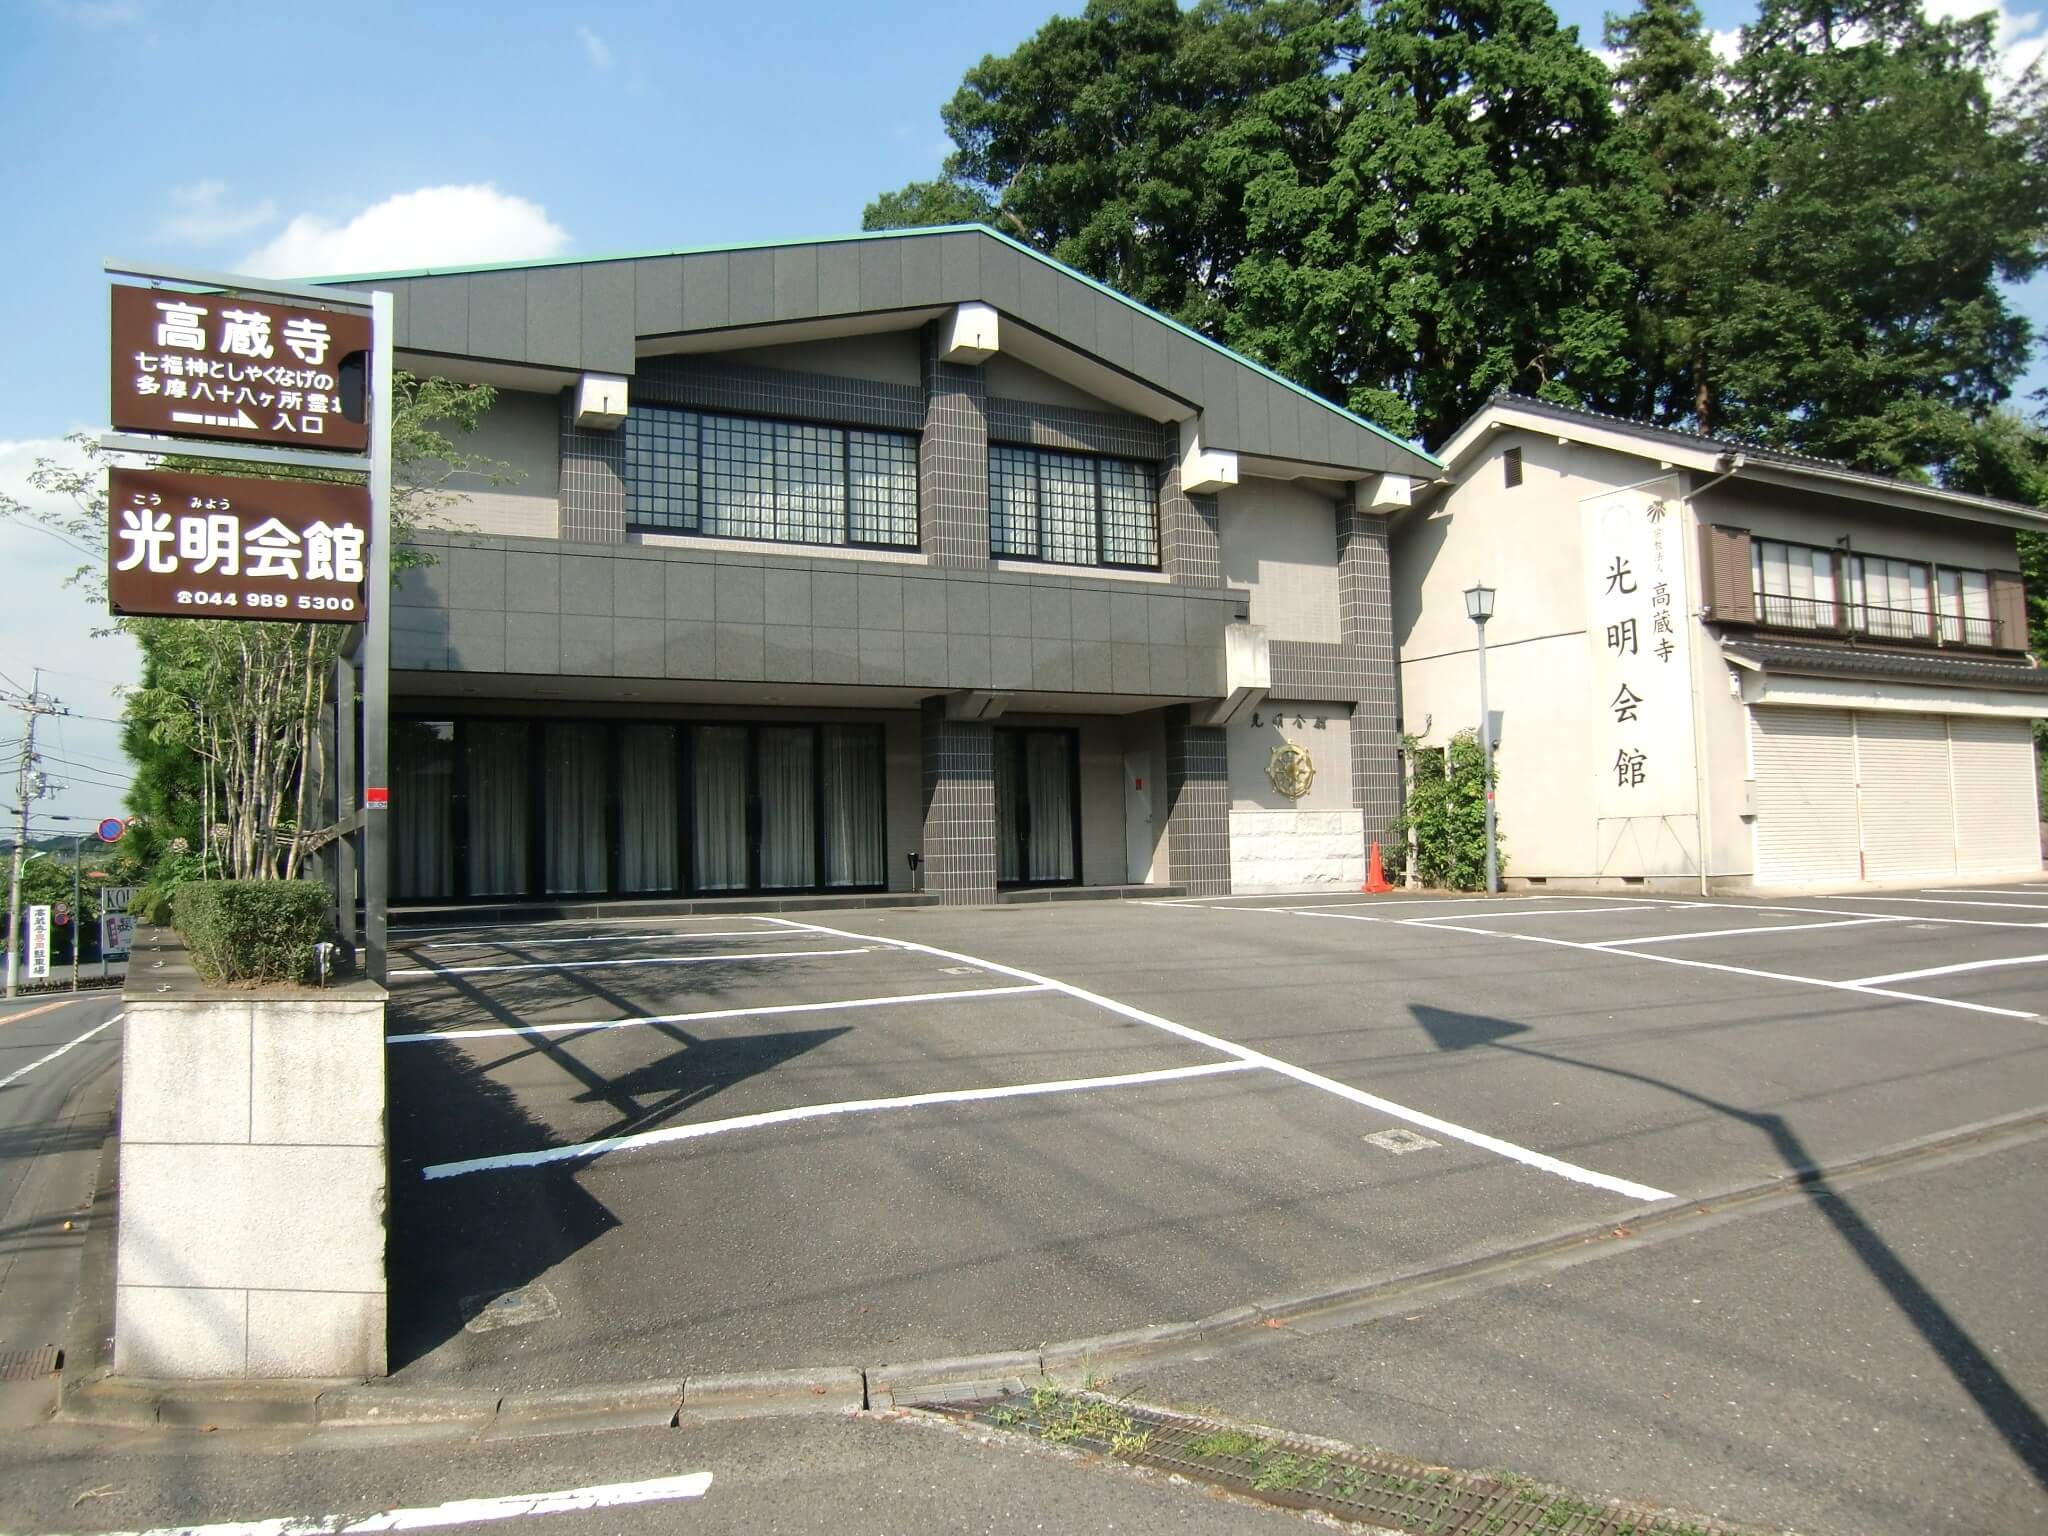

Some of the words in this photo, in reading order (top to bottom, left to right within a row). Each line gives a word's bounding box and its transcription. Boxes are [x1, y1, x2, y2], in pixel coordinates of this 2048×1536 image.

[156, 302, 331, 365] 高蔵寺
[272, 413, 323, 434] 入口
[133, 493, 161, 506] こう
[117, 509, 365, 583] 光明会館
[247, 593, 288, 608] 989
[298, 596, 354, 611] 5300
[1652, 582, 1675, 663] 高蔵寺
[1605, 555, 1648, 788] 光明会館
